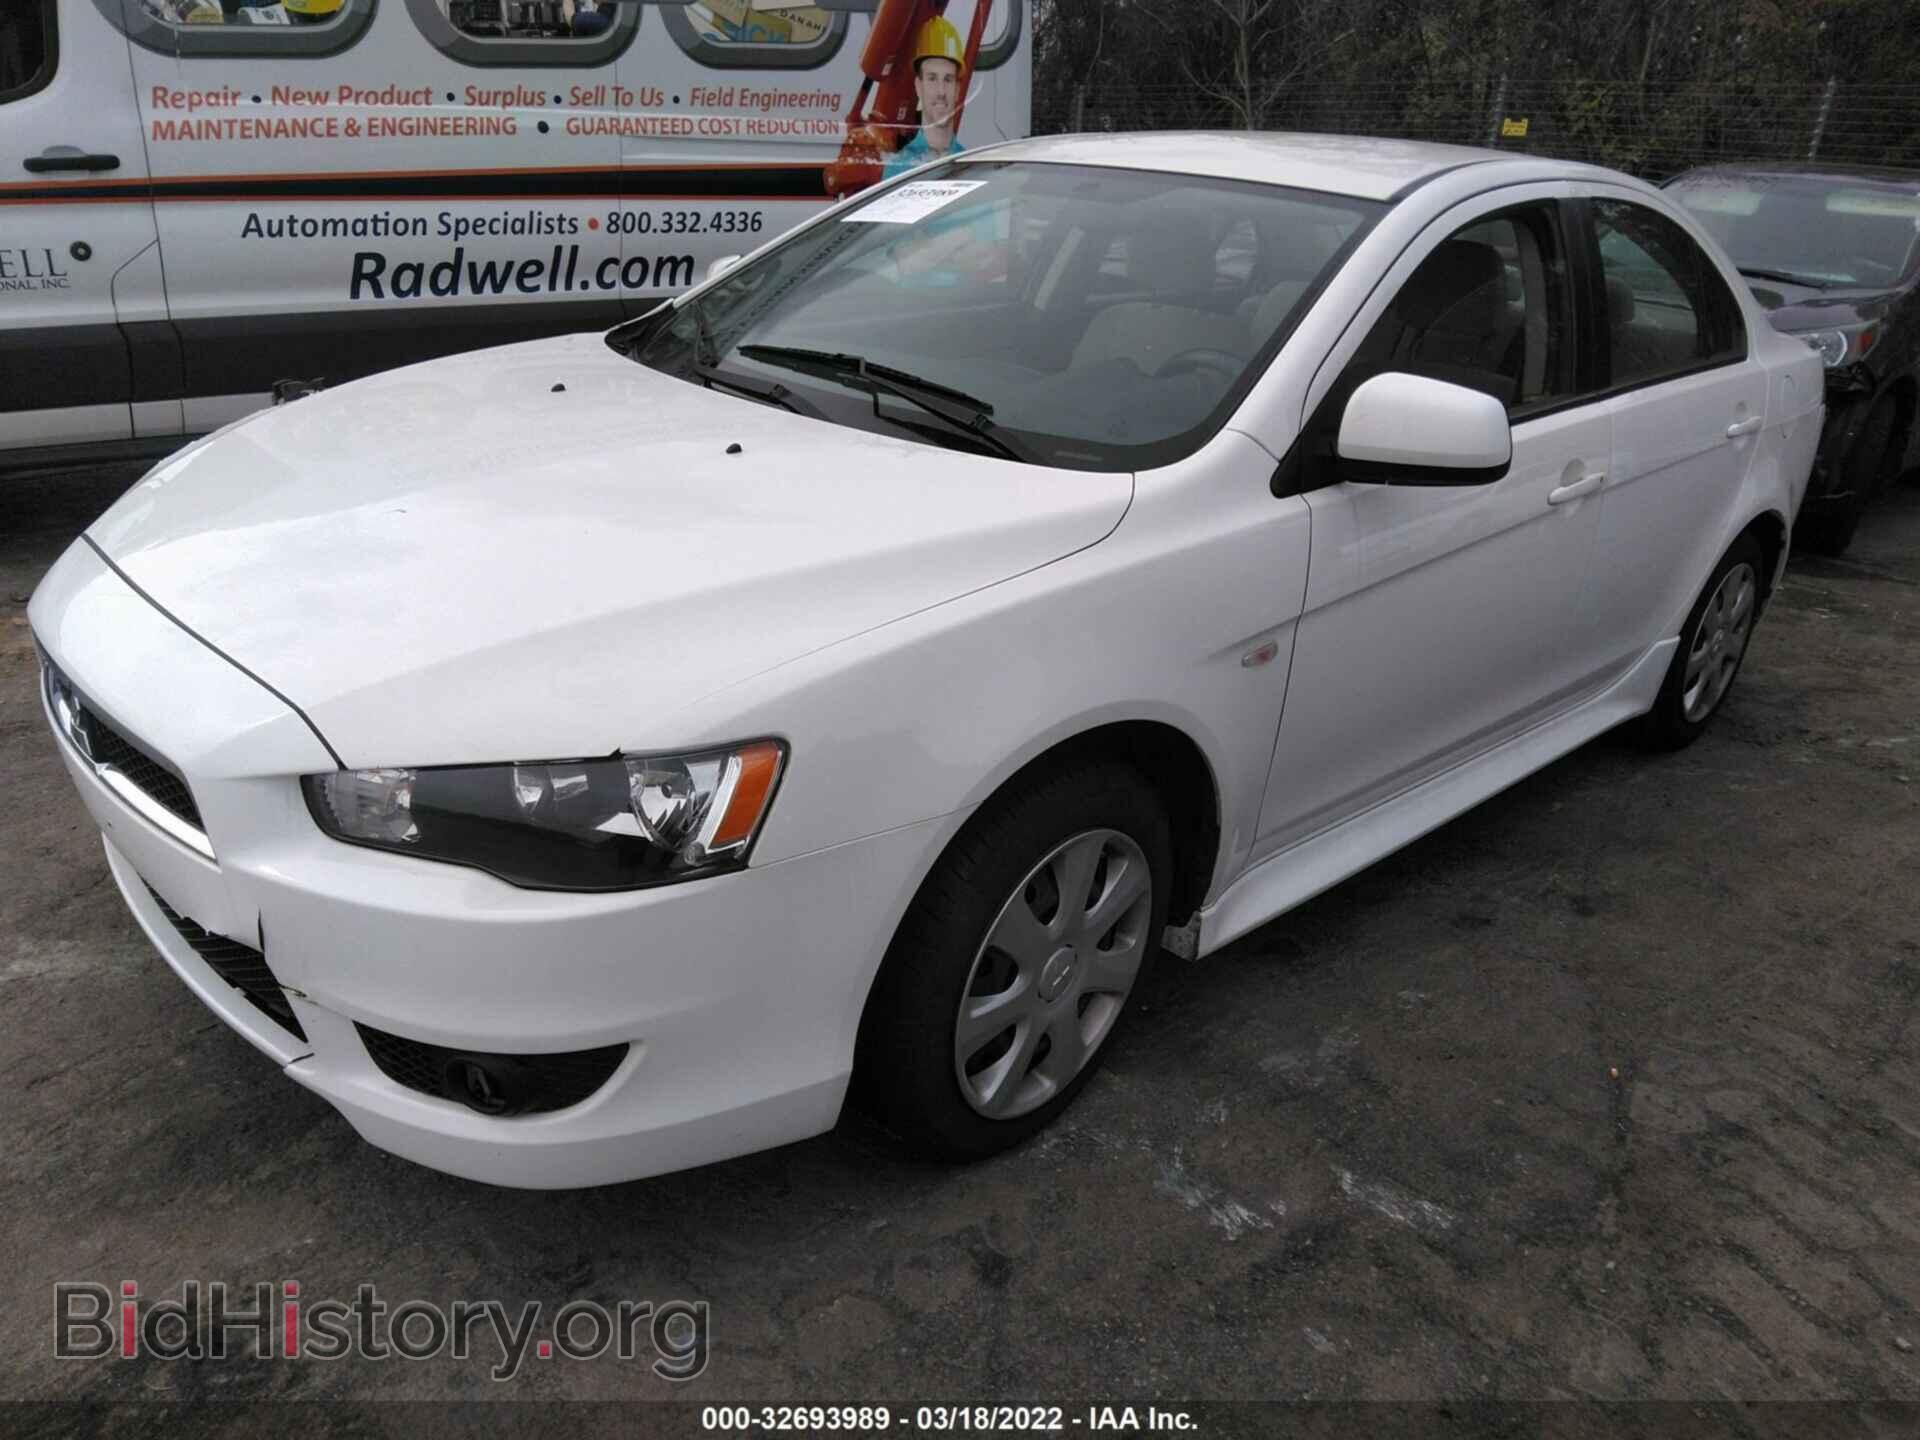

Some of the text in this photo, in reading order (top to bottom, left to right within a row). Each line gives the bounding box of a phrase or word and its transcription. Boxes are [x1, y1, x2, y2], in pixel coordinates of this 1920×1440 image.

[152, 85, 240, 111] Repair
[271, 84, 433, 107] New Product
[464, 85, 546, 109] Surplus
[569, 85, 664, 107] Sell To Us
[690, 86, 841, 112] Field Engineering
[152, 116, 517, 141] MAINTENANCE & ENGINEERING
[566, 117, 840, 136] GUARANTEED COST REDUCTION
[241, 210, 579, 241] Automation Specialists
[606, 211, 763, 235] 800.332.4336
[349, 244, 696, 301] Radwell.com
